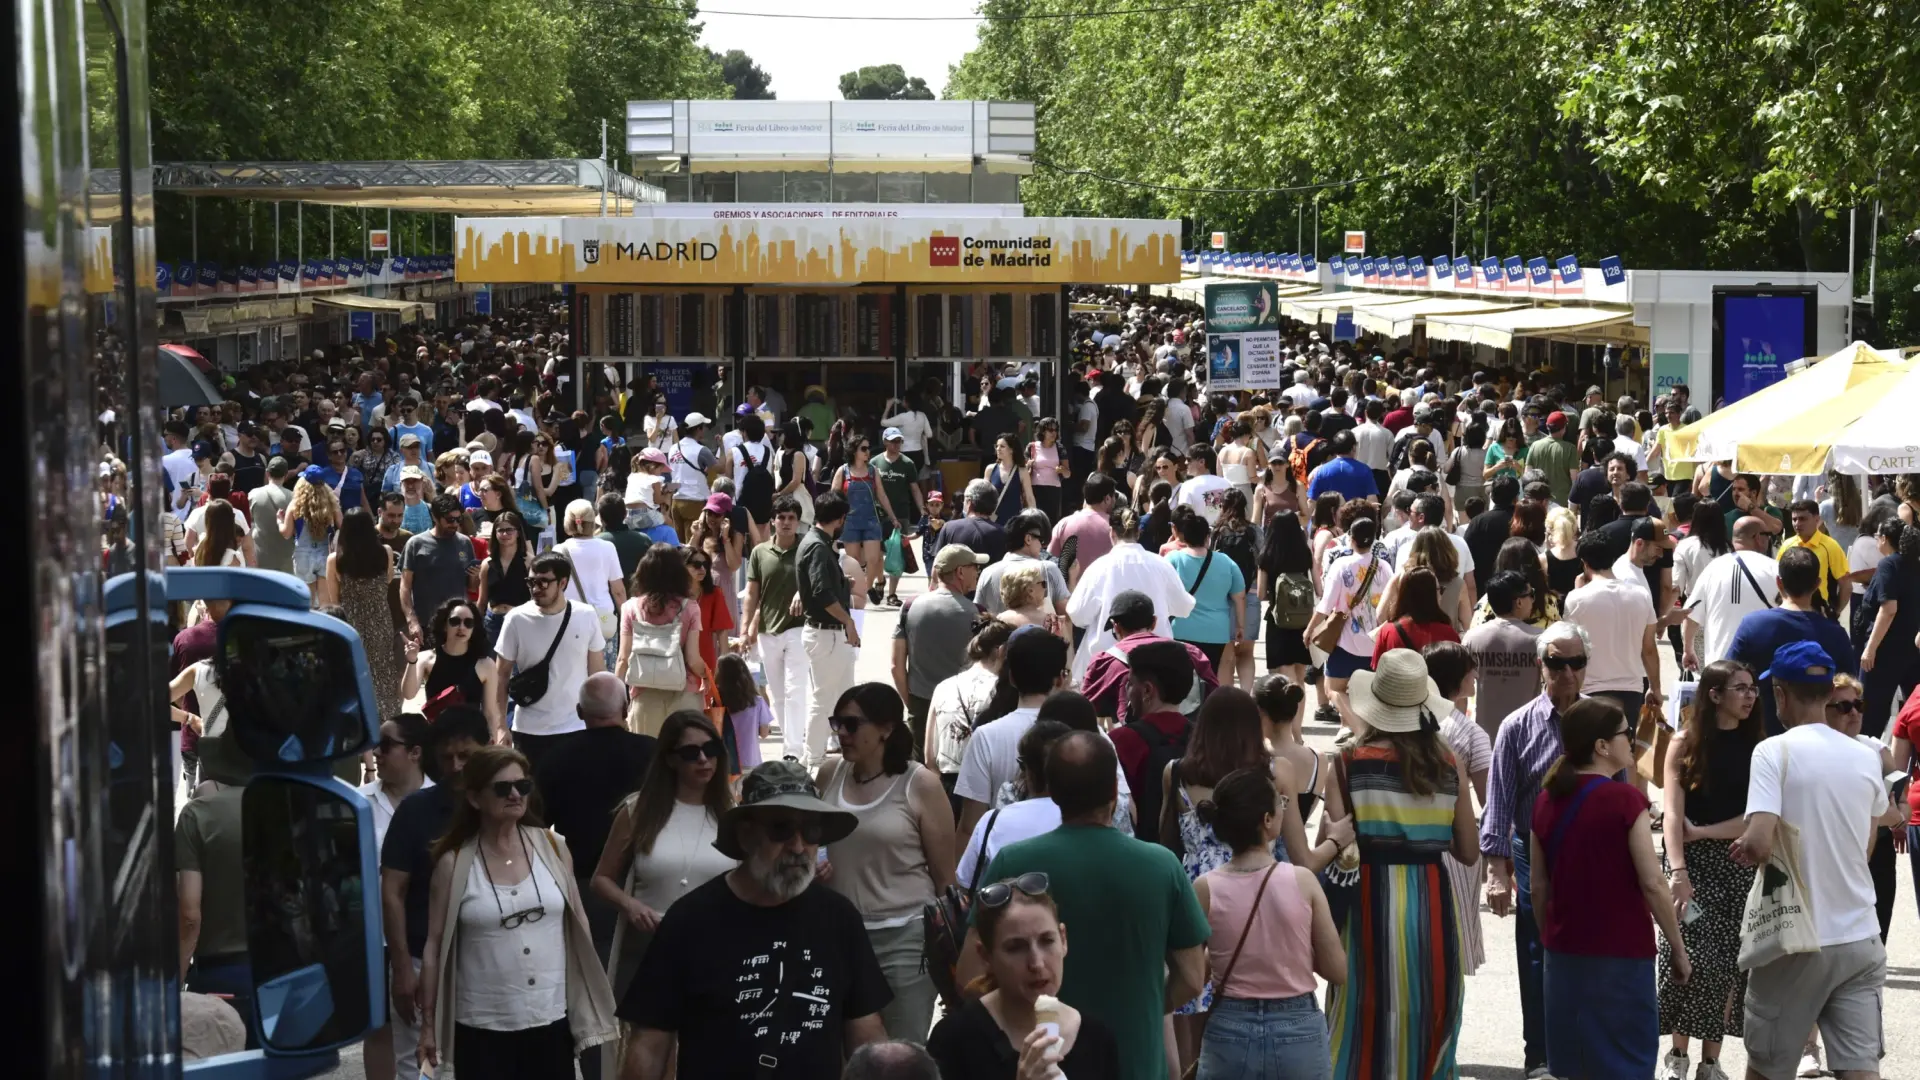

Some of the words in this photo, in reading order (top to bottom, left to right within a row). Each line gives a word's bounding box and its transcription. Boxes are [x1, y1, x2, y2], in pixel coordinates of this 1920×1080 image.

[736, 124, 754, 132] Feria
[756, 124, 767, 132] del
[769, 124, 788, 132] Libro
[878, 124, 897, 132] Feria
[898, 124, 909, 132] del
[912, 124, 930, 132] Libro
[963, 236, 1051, 249] Comunidad
[616, 242, 718, 261] MADRID
[963, 254, 984, 266] de
[990, 254, 1051, 266] Madrid
[352, 262, 363, 271] 358
[1412, 264, 1424, 272] 134
[1436, 263, 1448, 272] 133
[1456, 264, 1469, 273] 132
[1486, 265, 1498, 275] 131
[1508, 265, 1522, 275] 130
[1532, 265, 1546, 276] 129
[1562, 264, 1577, 275] 128
[1604, 266, 1620, 278] 128
[1868, 456, 1915, 471] CARTE
[888, 470, 905, 478] Jeans
[1472, 652, 1537, 668] GYMSHARK
